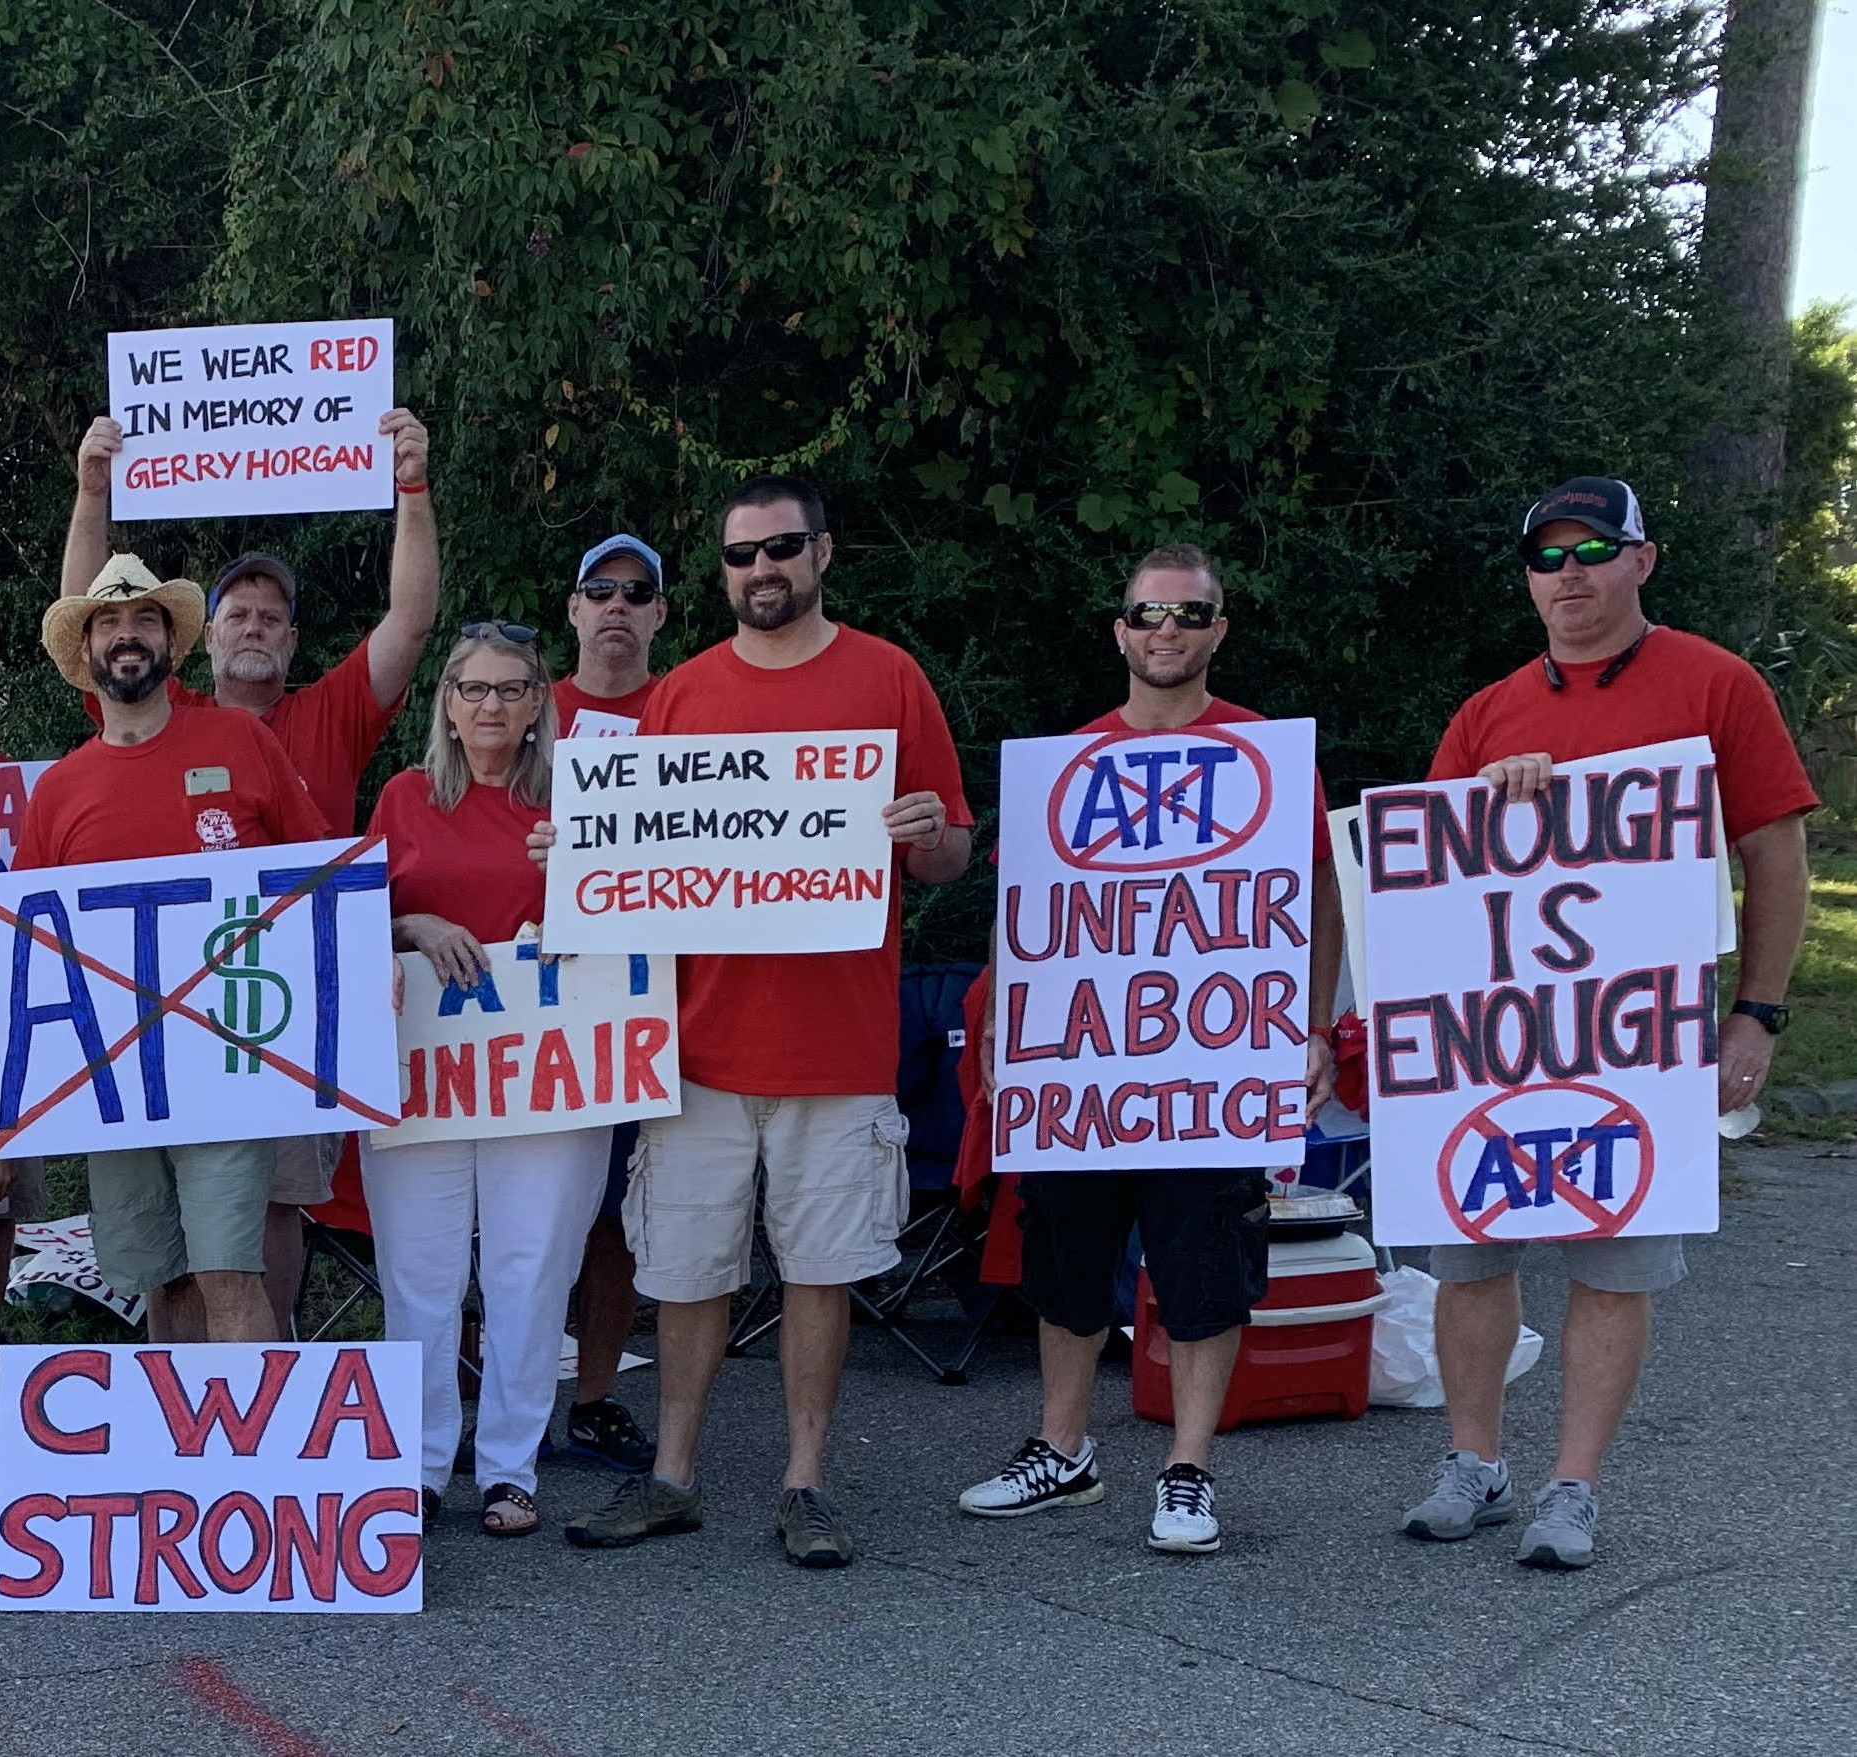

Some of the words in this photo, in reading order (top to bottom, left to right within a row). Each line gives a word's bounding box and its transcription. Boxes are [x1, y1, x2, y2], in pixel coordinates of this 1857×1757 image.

[128, 350, 183, 386] WE
[202, 343, 293, 381] WEAR
[310, 336, 379, 372] RED
[122, 402, 171, 439] IN
[183, 396, 303, 432] MEMORY
[314, 396, 353, 423] OF
[125, 451, 241, 489] GERRY
[246, 444, 373, 481] HORGAN
[571, 753, 638, 792] WE
[658, 749, 770, 784] WEAR
[794, 743, 882, 781] RED
[570, 813, 617, 850] IN
[634, 809, 788, 843] MEMORY
[799, 808, 846, 838] OF
[1365, 766, 1716, 892] ENOUGH
[576, 866, 731, 915] GERRY
[733, 868, 883, 908] HORGAN
[1006, 869, 1308, 961] UNFAIR
[1484, 882, 1601, 982] IS
[1006, 970, 1308, 1064] LABOR
[1373, 963, 1719, 1096] ENOUGH
[996, 1077, 1306, 1155] PRACTICE
[19, 1348, 402, 1460] CWA
